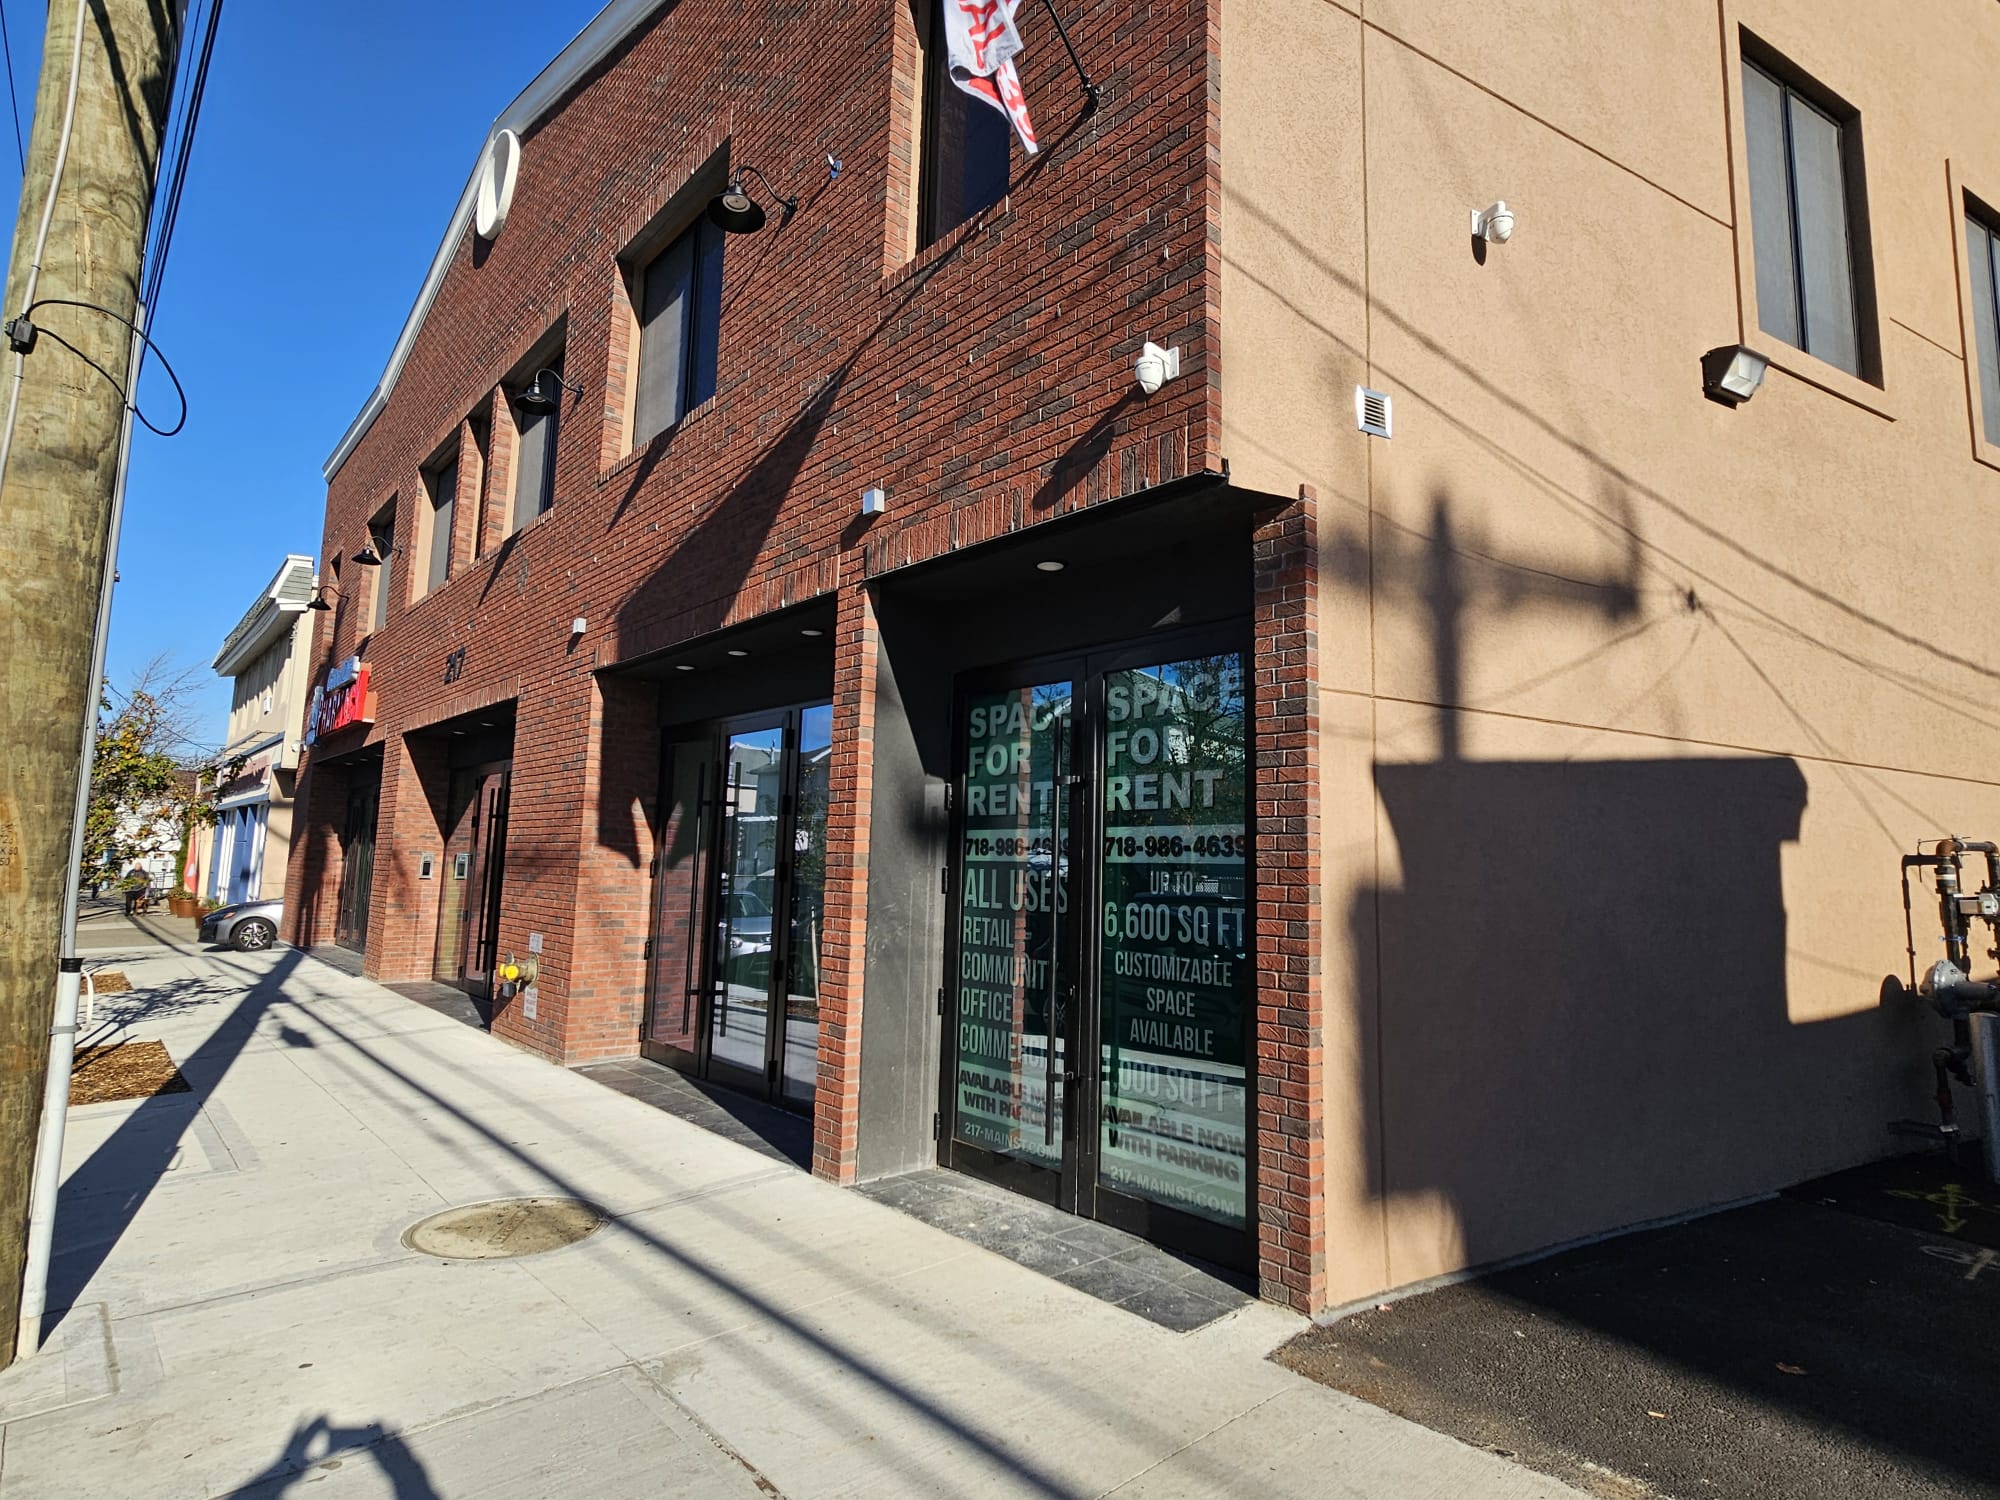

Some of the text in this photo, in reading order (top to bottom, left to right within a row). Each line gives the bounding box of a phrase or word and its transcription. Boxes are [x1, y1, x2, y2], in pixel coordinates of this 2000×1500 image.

[969, 700, 1071, 739] SPAC
[968, 741, 1032, 778] FOR
[967, 780, 1055, 816] RENT
[1106, 769, 1224, 812] RENT
[1104, 835, 1245, 858] 718-986-4639
[963, 867, 1068, 914] ALL USES
[1174, 870, 1194, 896] TO
[962, 915, 1014, 948] RETAIL
[1104, 901, 1245, 947] 6,600 SQ FT
[1115, 951, 1233, 988] CUSTOMIZABLE
[960, 986, 1013, 1024] OFFICE
[1146, 987, 1196, 1018] SPACE
[1130, 1018, 1215, 1056] AVAILABLE
[963, 1091, 996, 1114] WITH
[1108, 1128, 1240, 1184] WITH PARKING
